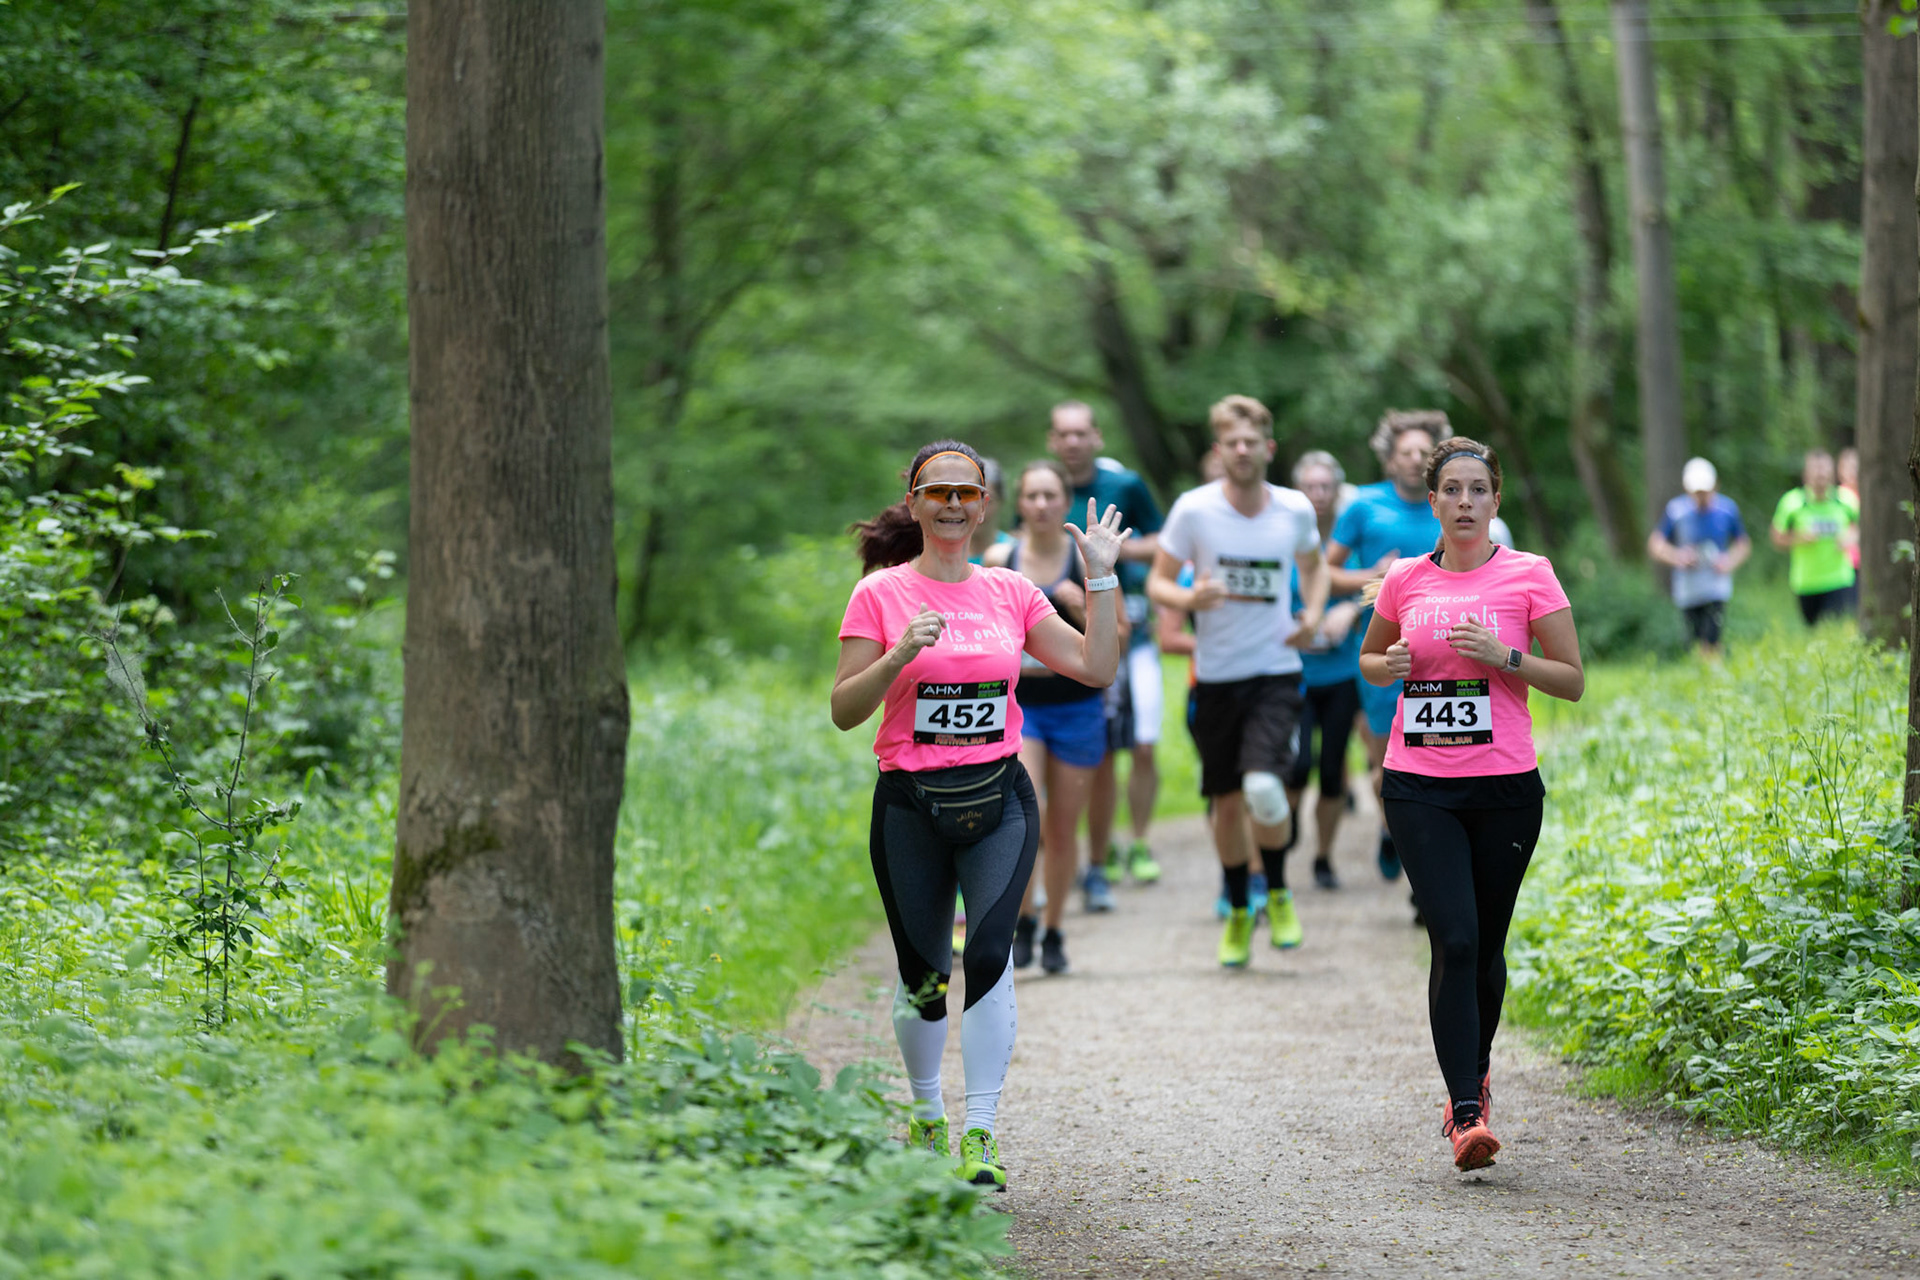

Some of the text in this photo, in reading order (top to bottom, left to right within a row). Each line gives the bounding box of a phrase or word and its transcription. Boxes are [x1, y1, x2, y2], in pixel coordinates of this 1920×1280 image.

[1425, 595, 1480, 604] BOOT CAMP
[958, 611, 984, 621] CAMP
[1403, 605, 1502, 638] girls only
[939, 622, 1015, 655] rls only
[1432, 629, 1453, 640] 201
[952, 643, 983, 652] 2018
[923, 685, 963, 695] AHM
[1409, 682, 1443, 693] AHM
[928, 702, 996, 729] 452
[1415, 701, 1478, 727] 443
